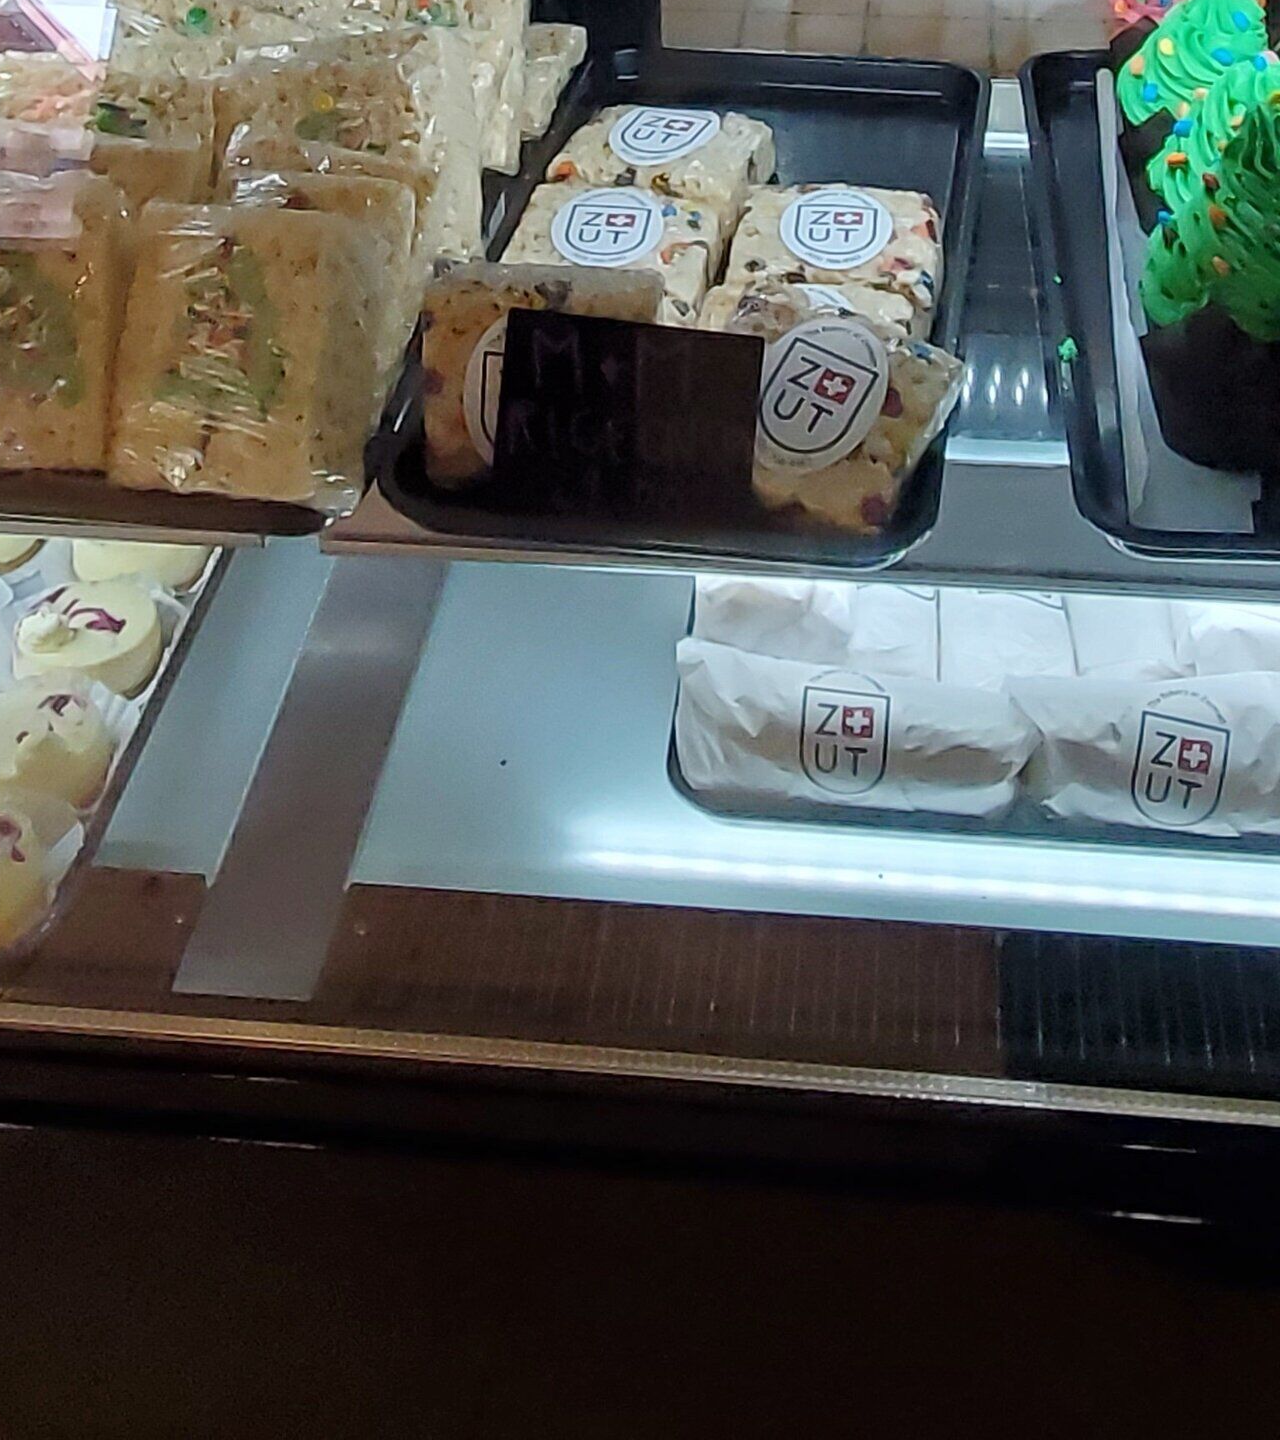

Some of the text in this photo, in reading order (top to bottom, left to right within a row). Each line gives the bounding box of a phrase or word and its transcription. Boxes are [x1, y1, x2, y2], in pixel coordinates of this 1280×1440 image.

[578, 228, 630, 245] UT
[808, 227, 860, 244] UT
[773, 388, 834, 434] UT
[814, 742, 869, 777] UT
[1144, 771, 1203, 810] UT
